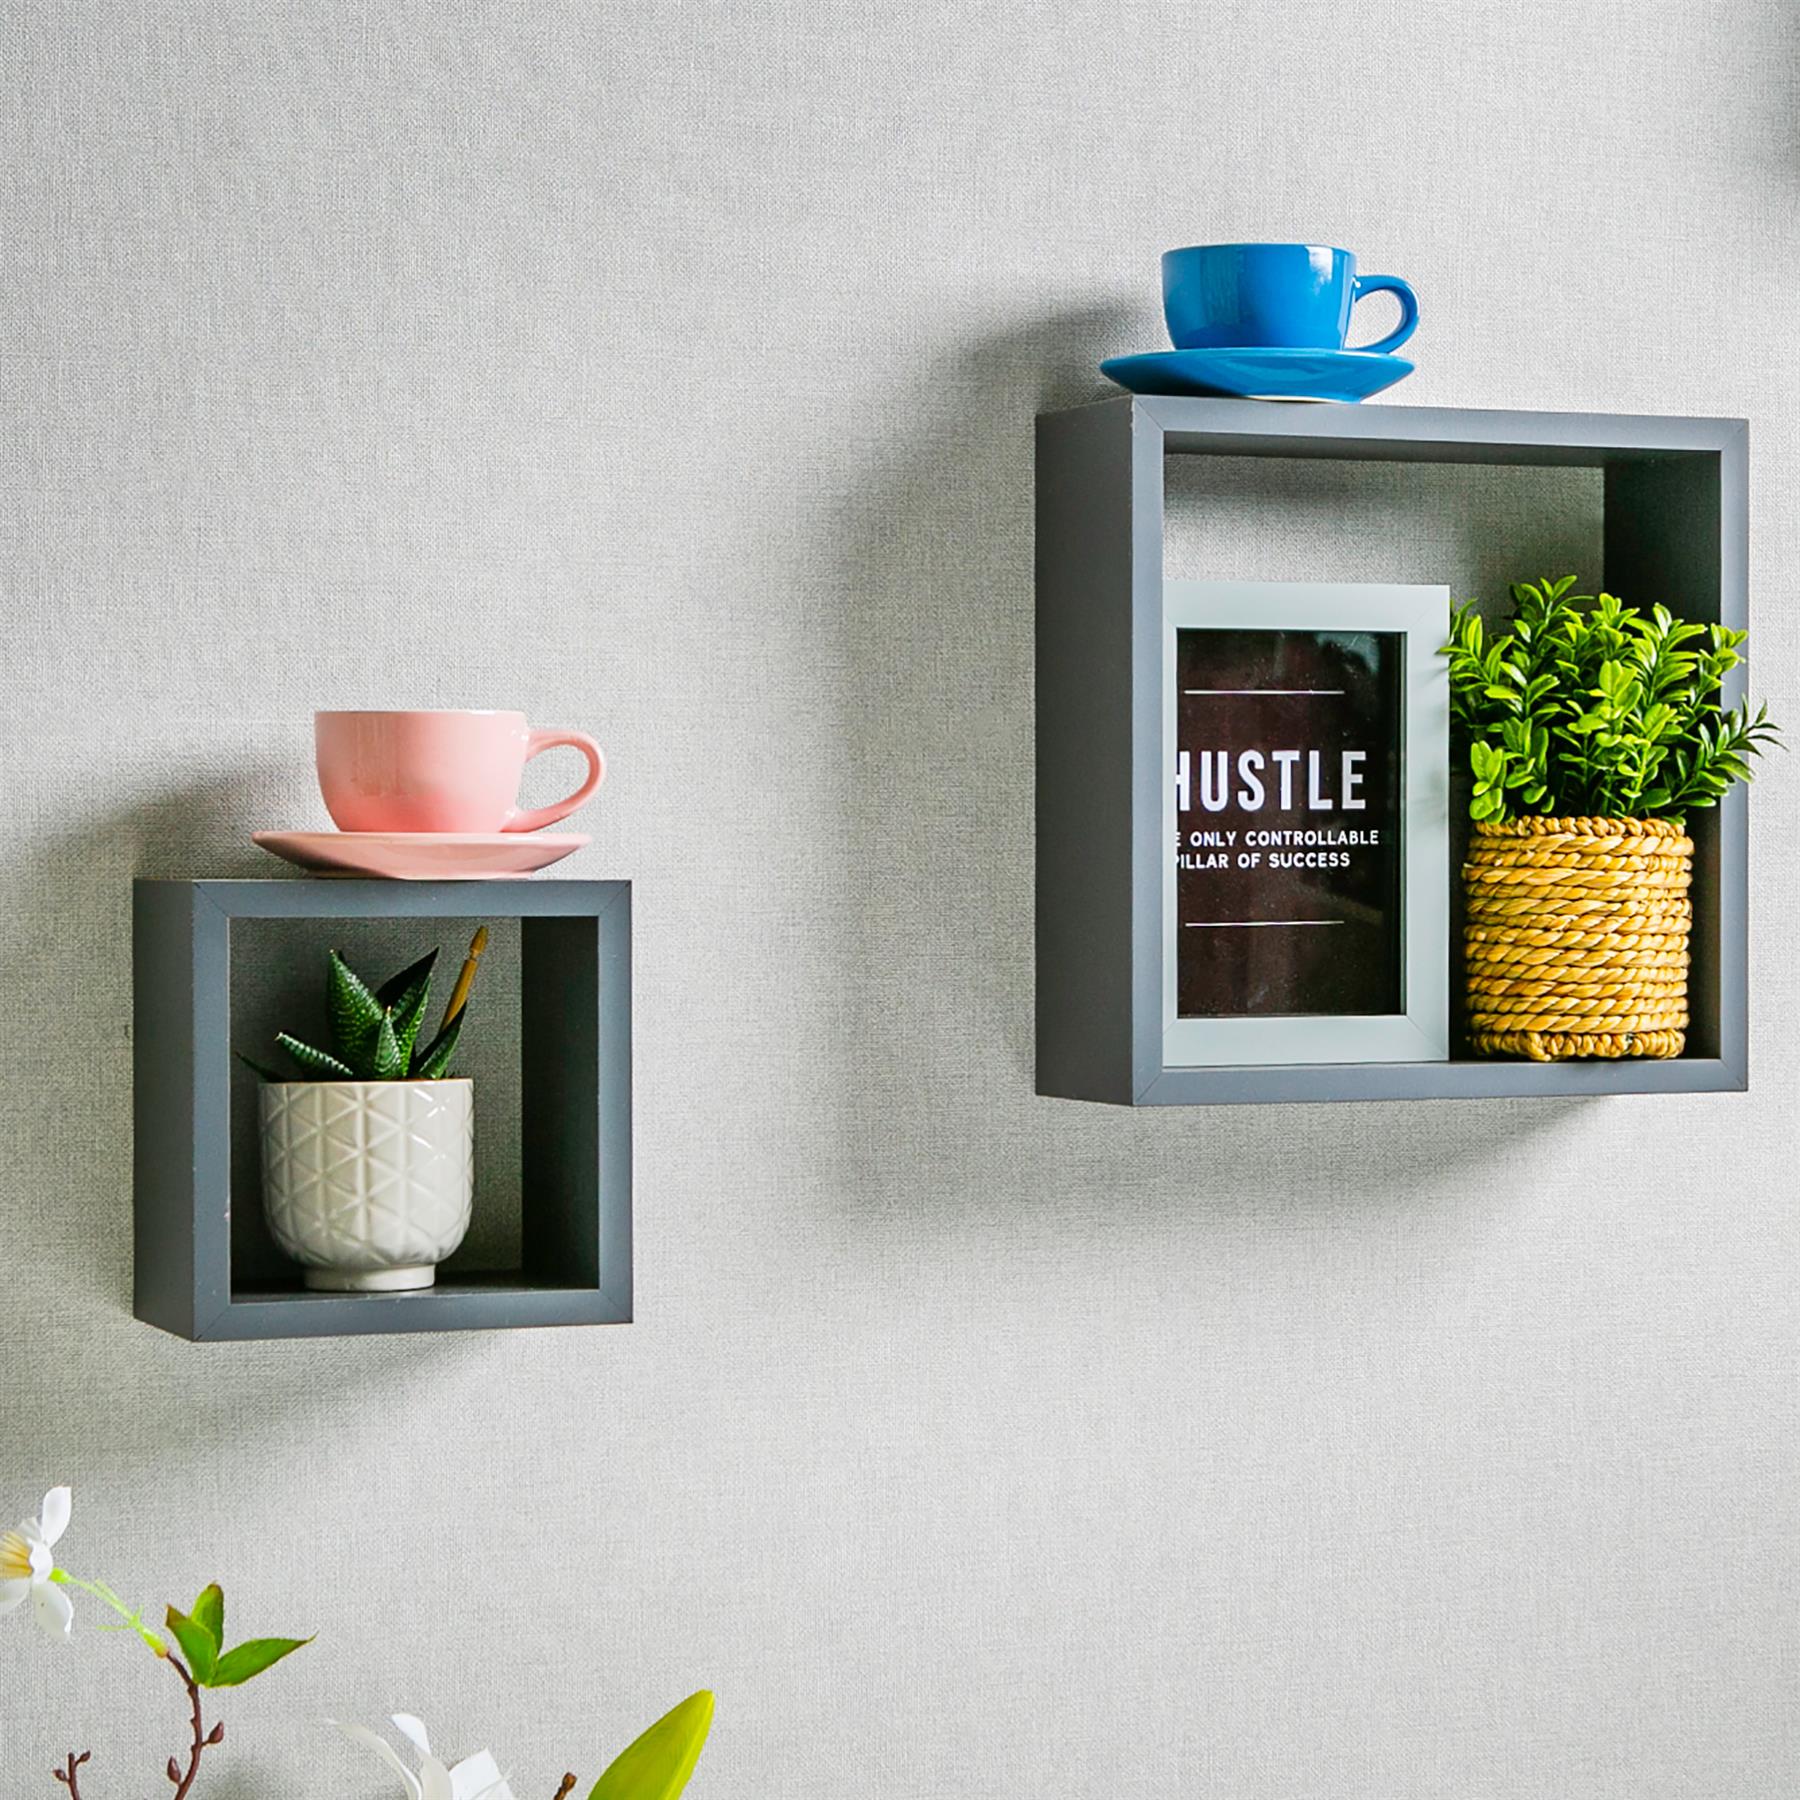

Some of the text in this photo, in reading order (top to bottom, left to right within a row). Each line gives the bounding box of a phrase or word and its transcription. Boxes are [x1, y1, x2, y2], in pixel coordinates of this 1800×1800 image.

[1189, 830, 1237, 847] ONLY
[1244, 829, 1379, 846] CONTROLLABLE
[1177, 852, 1351, 869] ILLAR OF SUCCESS
